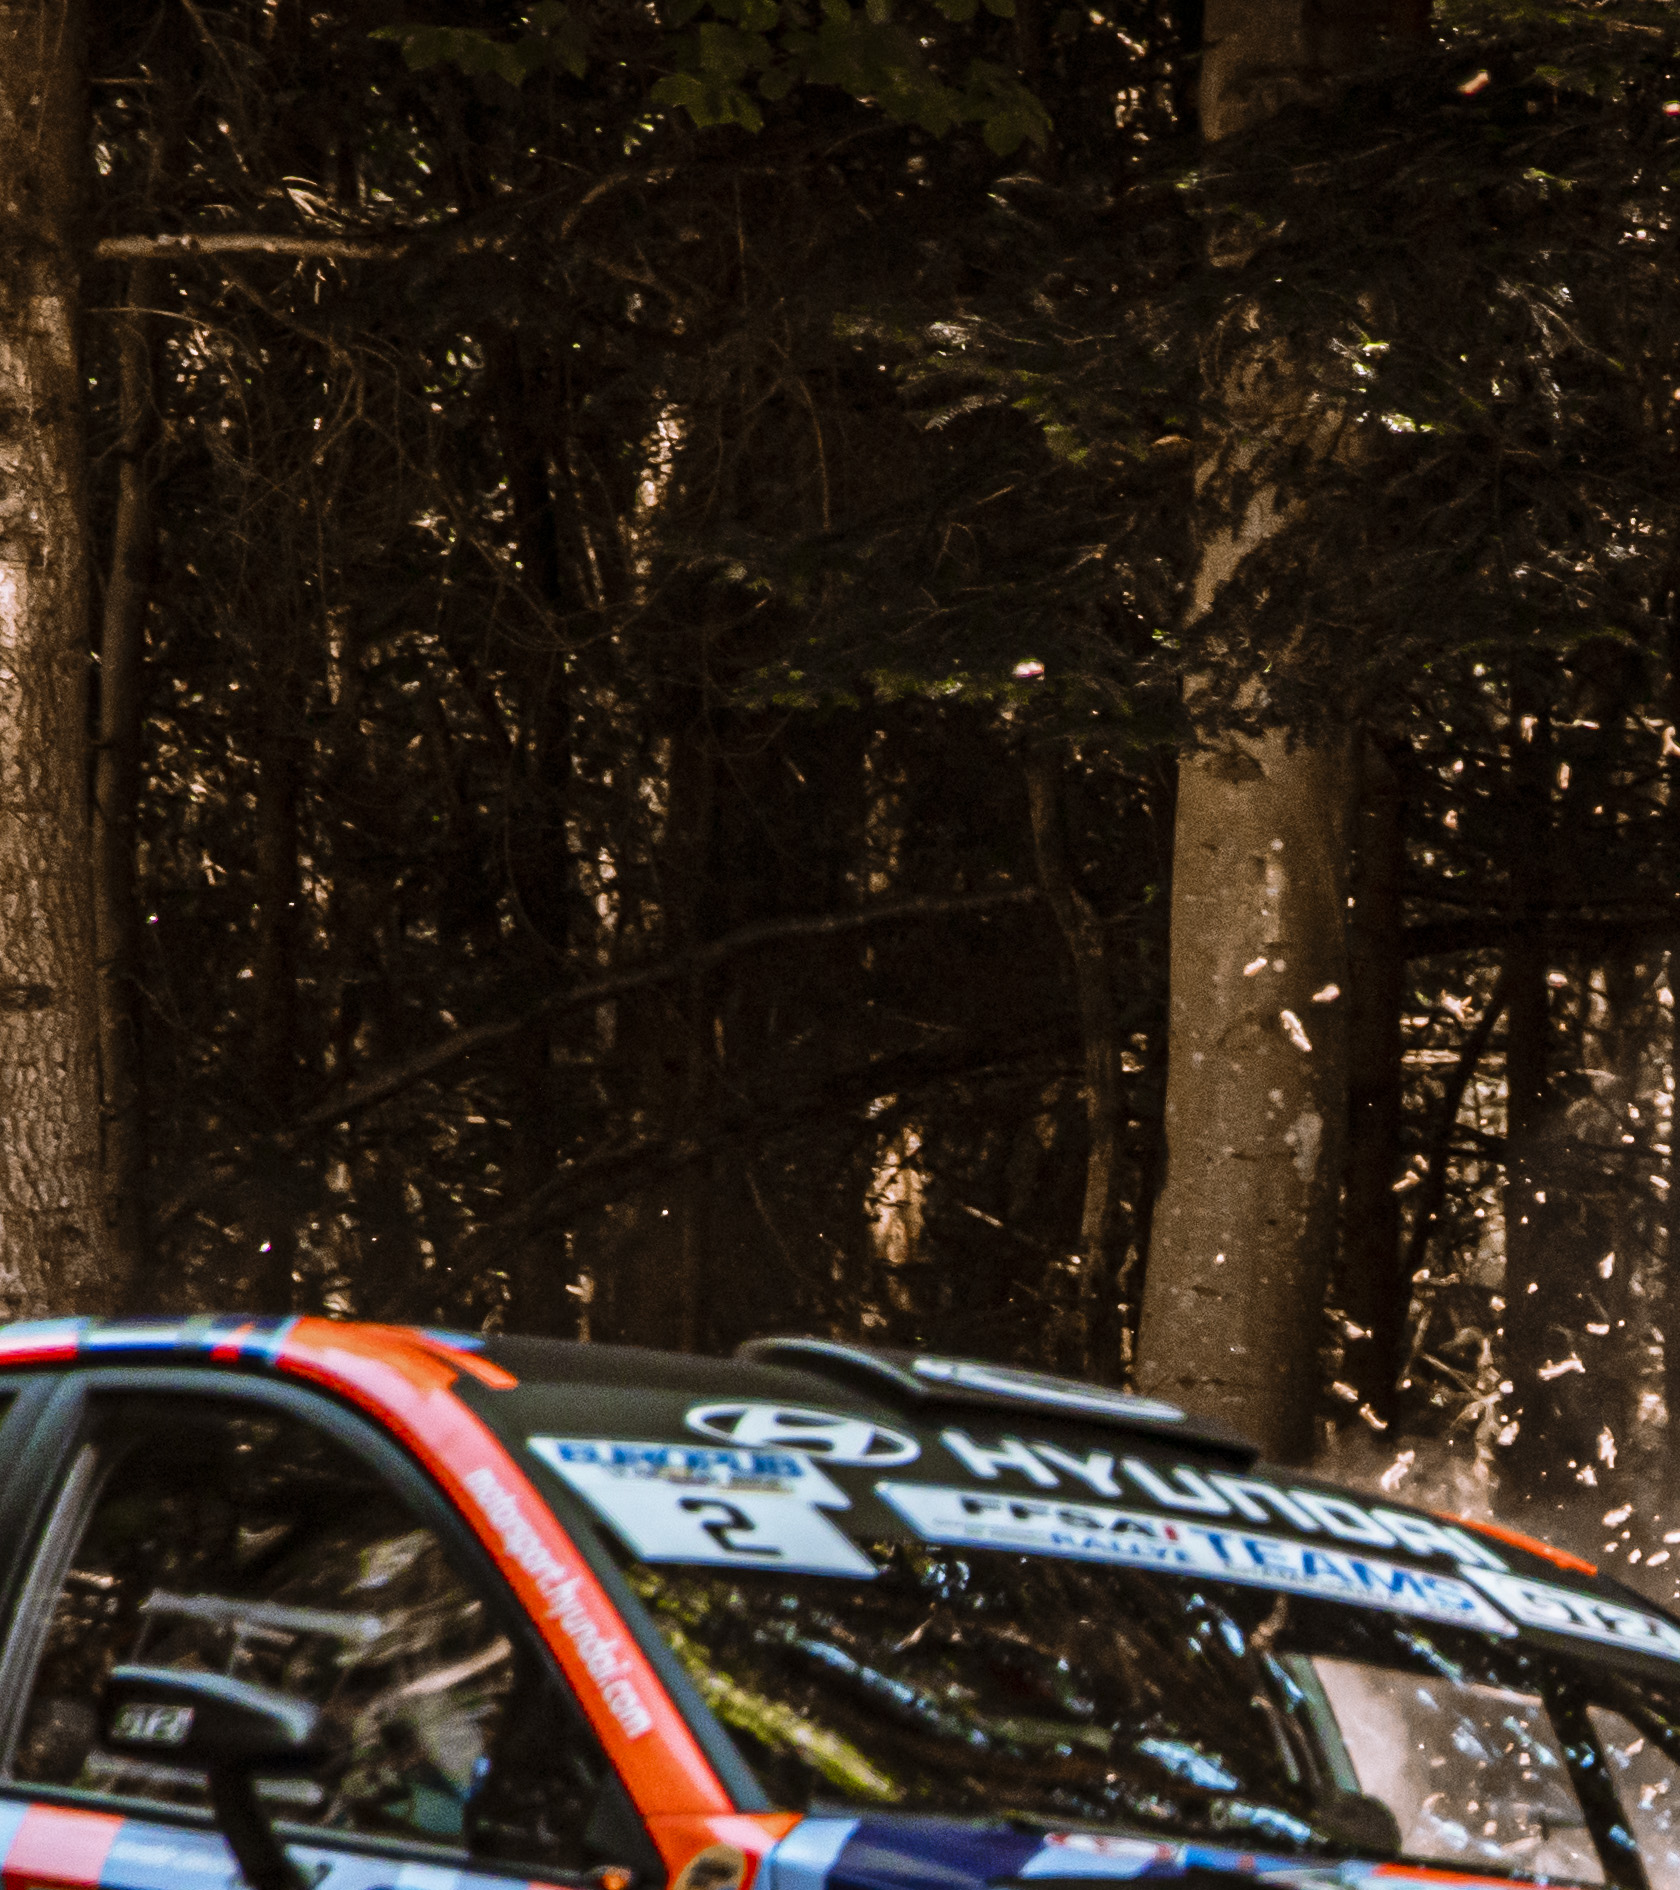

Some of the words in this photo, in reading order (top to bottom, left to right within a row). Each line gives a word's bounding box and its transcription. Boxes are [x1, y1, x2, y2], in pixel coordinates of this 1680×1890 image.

[678, 1496, 784, 1557] 2
[938, 1427, 1514, 1573] HYUNDAI
[464, 1466, 653, 1741] motorsport.hyundai.com
[1188, 1525, 1476, 1616] TEAMS
